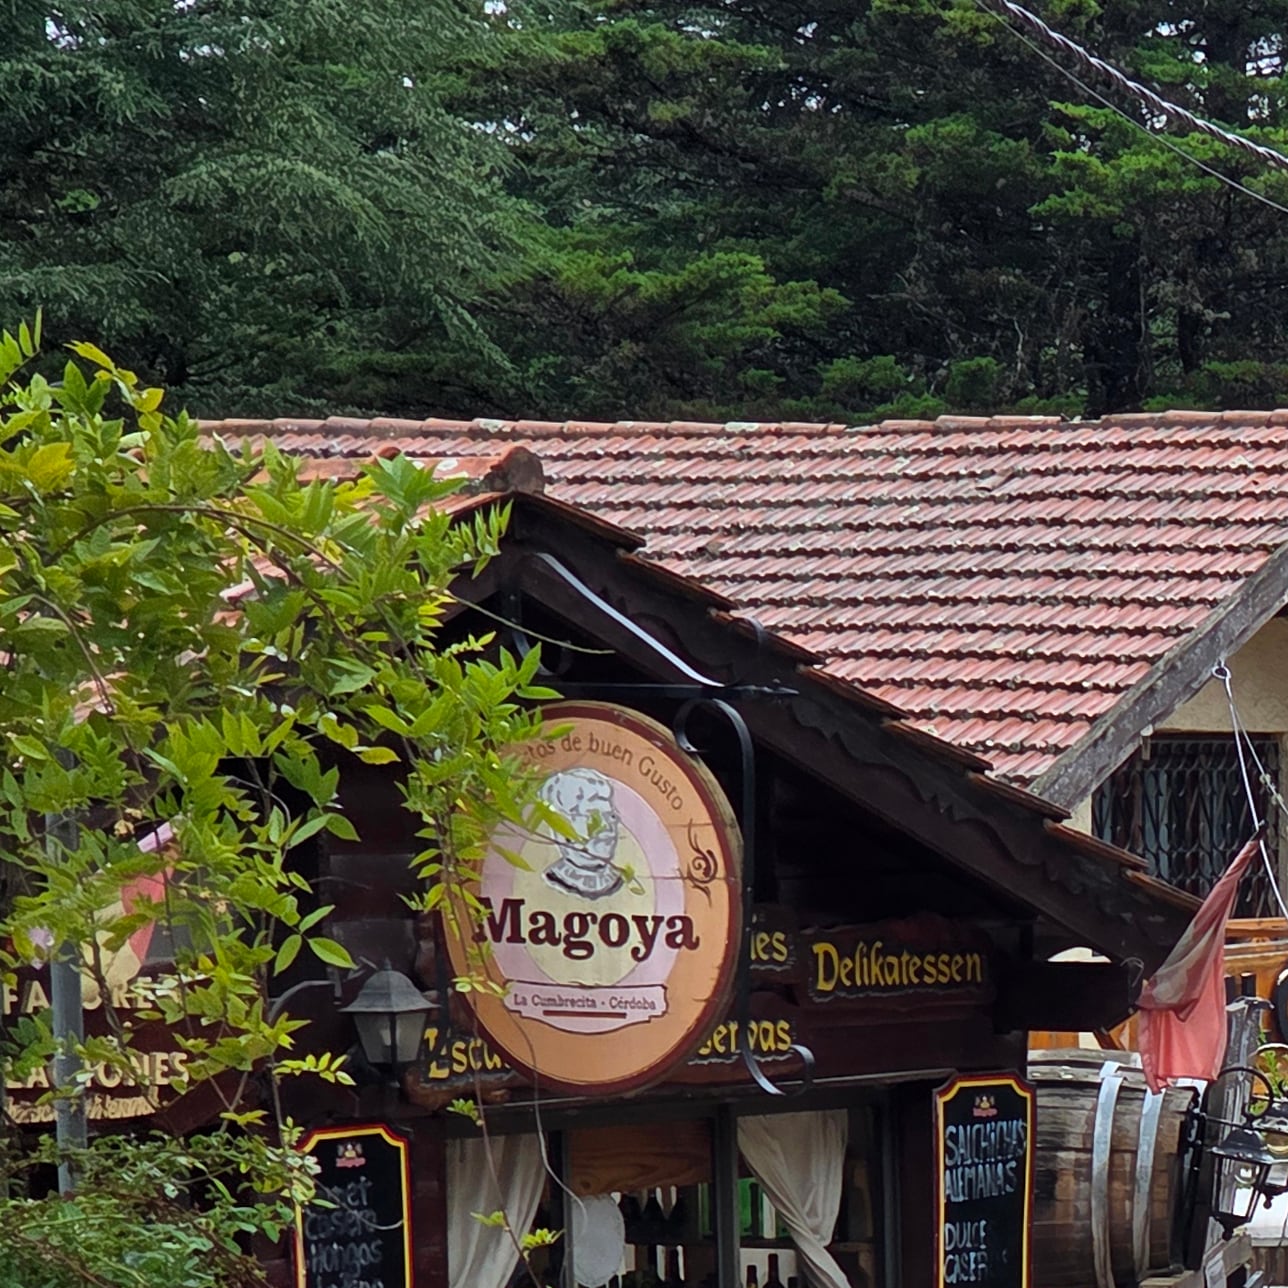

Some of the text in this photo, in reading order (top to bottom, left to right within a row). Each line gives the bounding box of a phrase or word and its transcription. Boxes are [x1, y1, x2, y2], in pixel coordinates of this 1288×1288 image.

[561, 732, 582, 752] de
[589, 731, 634, 766] buen
[638, 756, 683, 811] Gusto
[472, 896, 700, 963] Magoya
[811, 940, 983, 991] Delikatessen
[513, 993, 528, 1007] La
